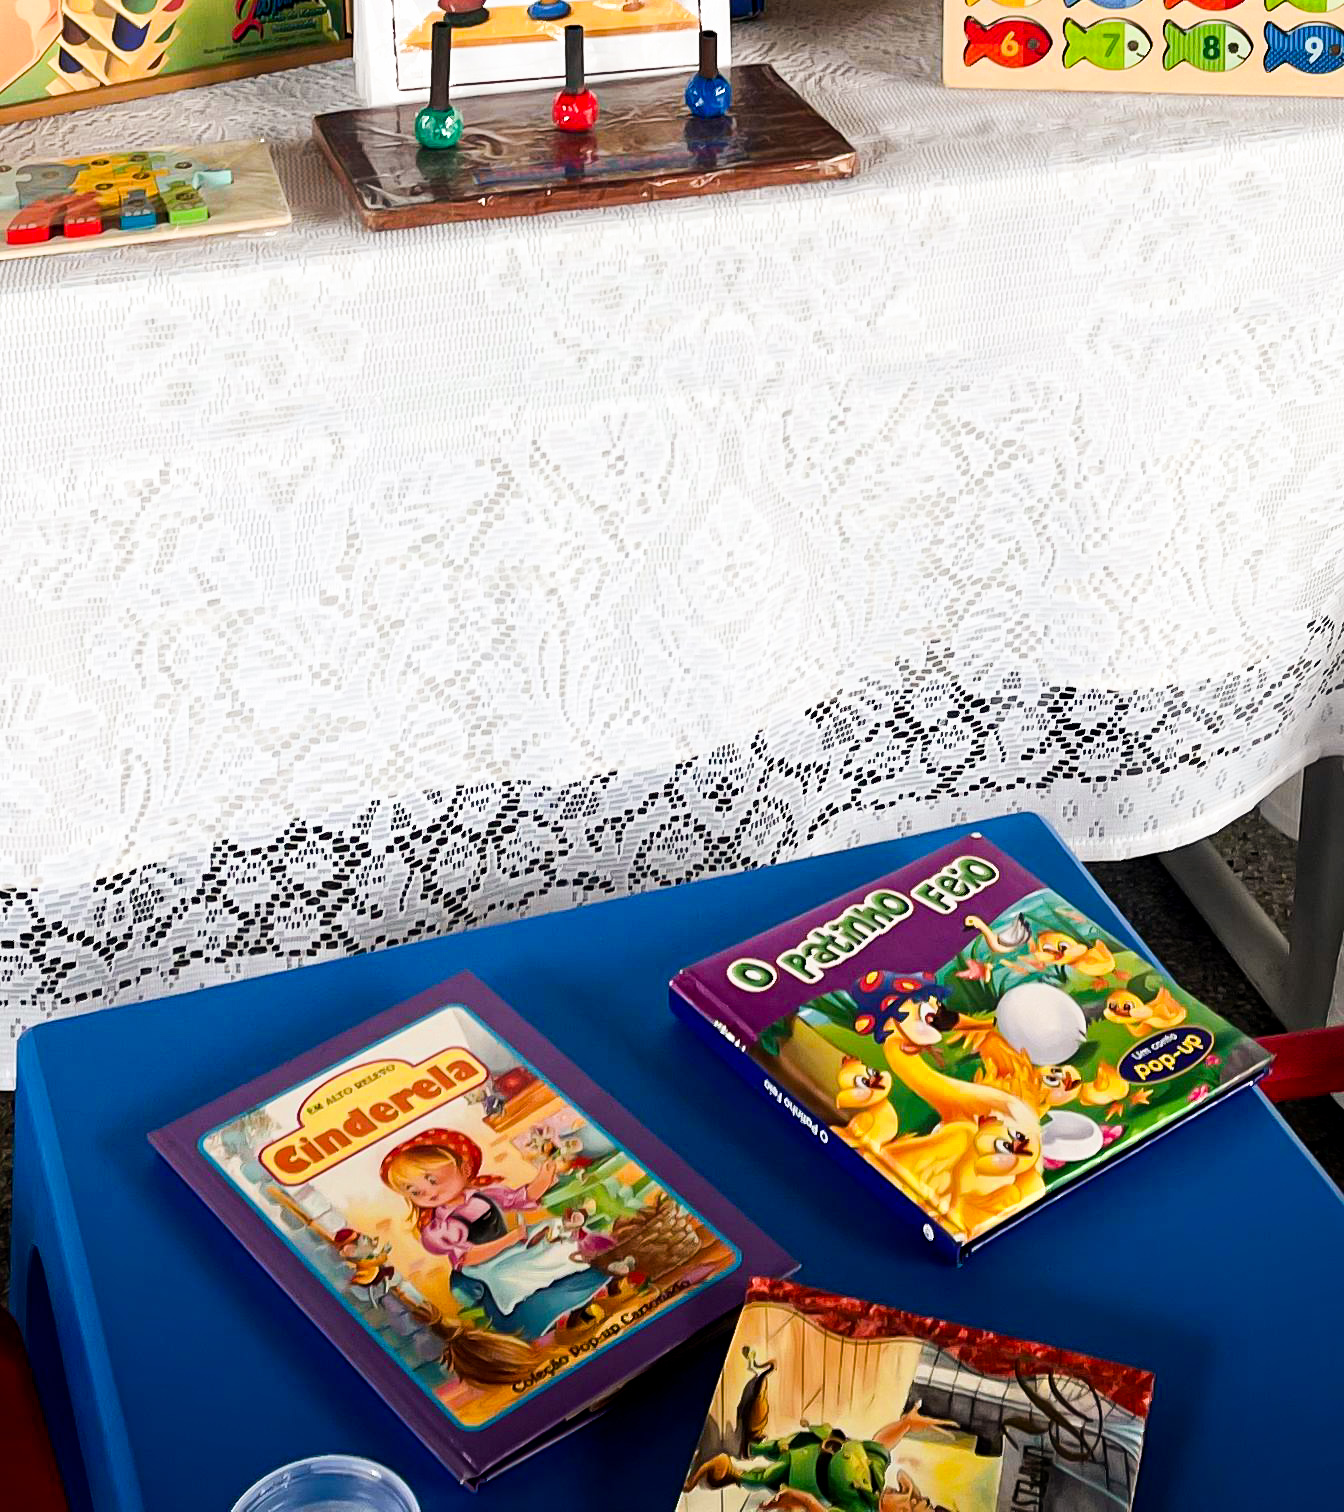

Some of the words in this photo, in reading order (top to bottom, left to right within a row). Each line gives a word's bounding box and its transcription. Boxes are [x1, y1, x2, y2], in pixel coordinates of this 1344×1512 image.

[1000, 31, 1019, 56] 6
[1103, 32, 1121, 56] 7
[1202, 35, 1220, 59] 8
[1304, 39, 1324, 64] 9
[729, 958, 776, 991] O
[778, 889, 913, 985] Patinho
[1131, 1048, 1151, 1060] Um
[1151, 1033, 1177, 1050] conto
[1134, 1034, 1203, 1080] pop-up
[274, 1060, 479, 1173] Cinderela
[307, 1102, 323, 1115] EM
[326, 1087, 353, 1106] ALTO
[784, 1097, 818, 1135] Patinho
[820, 1129, 828, 1144] O
